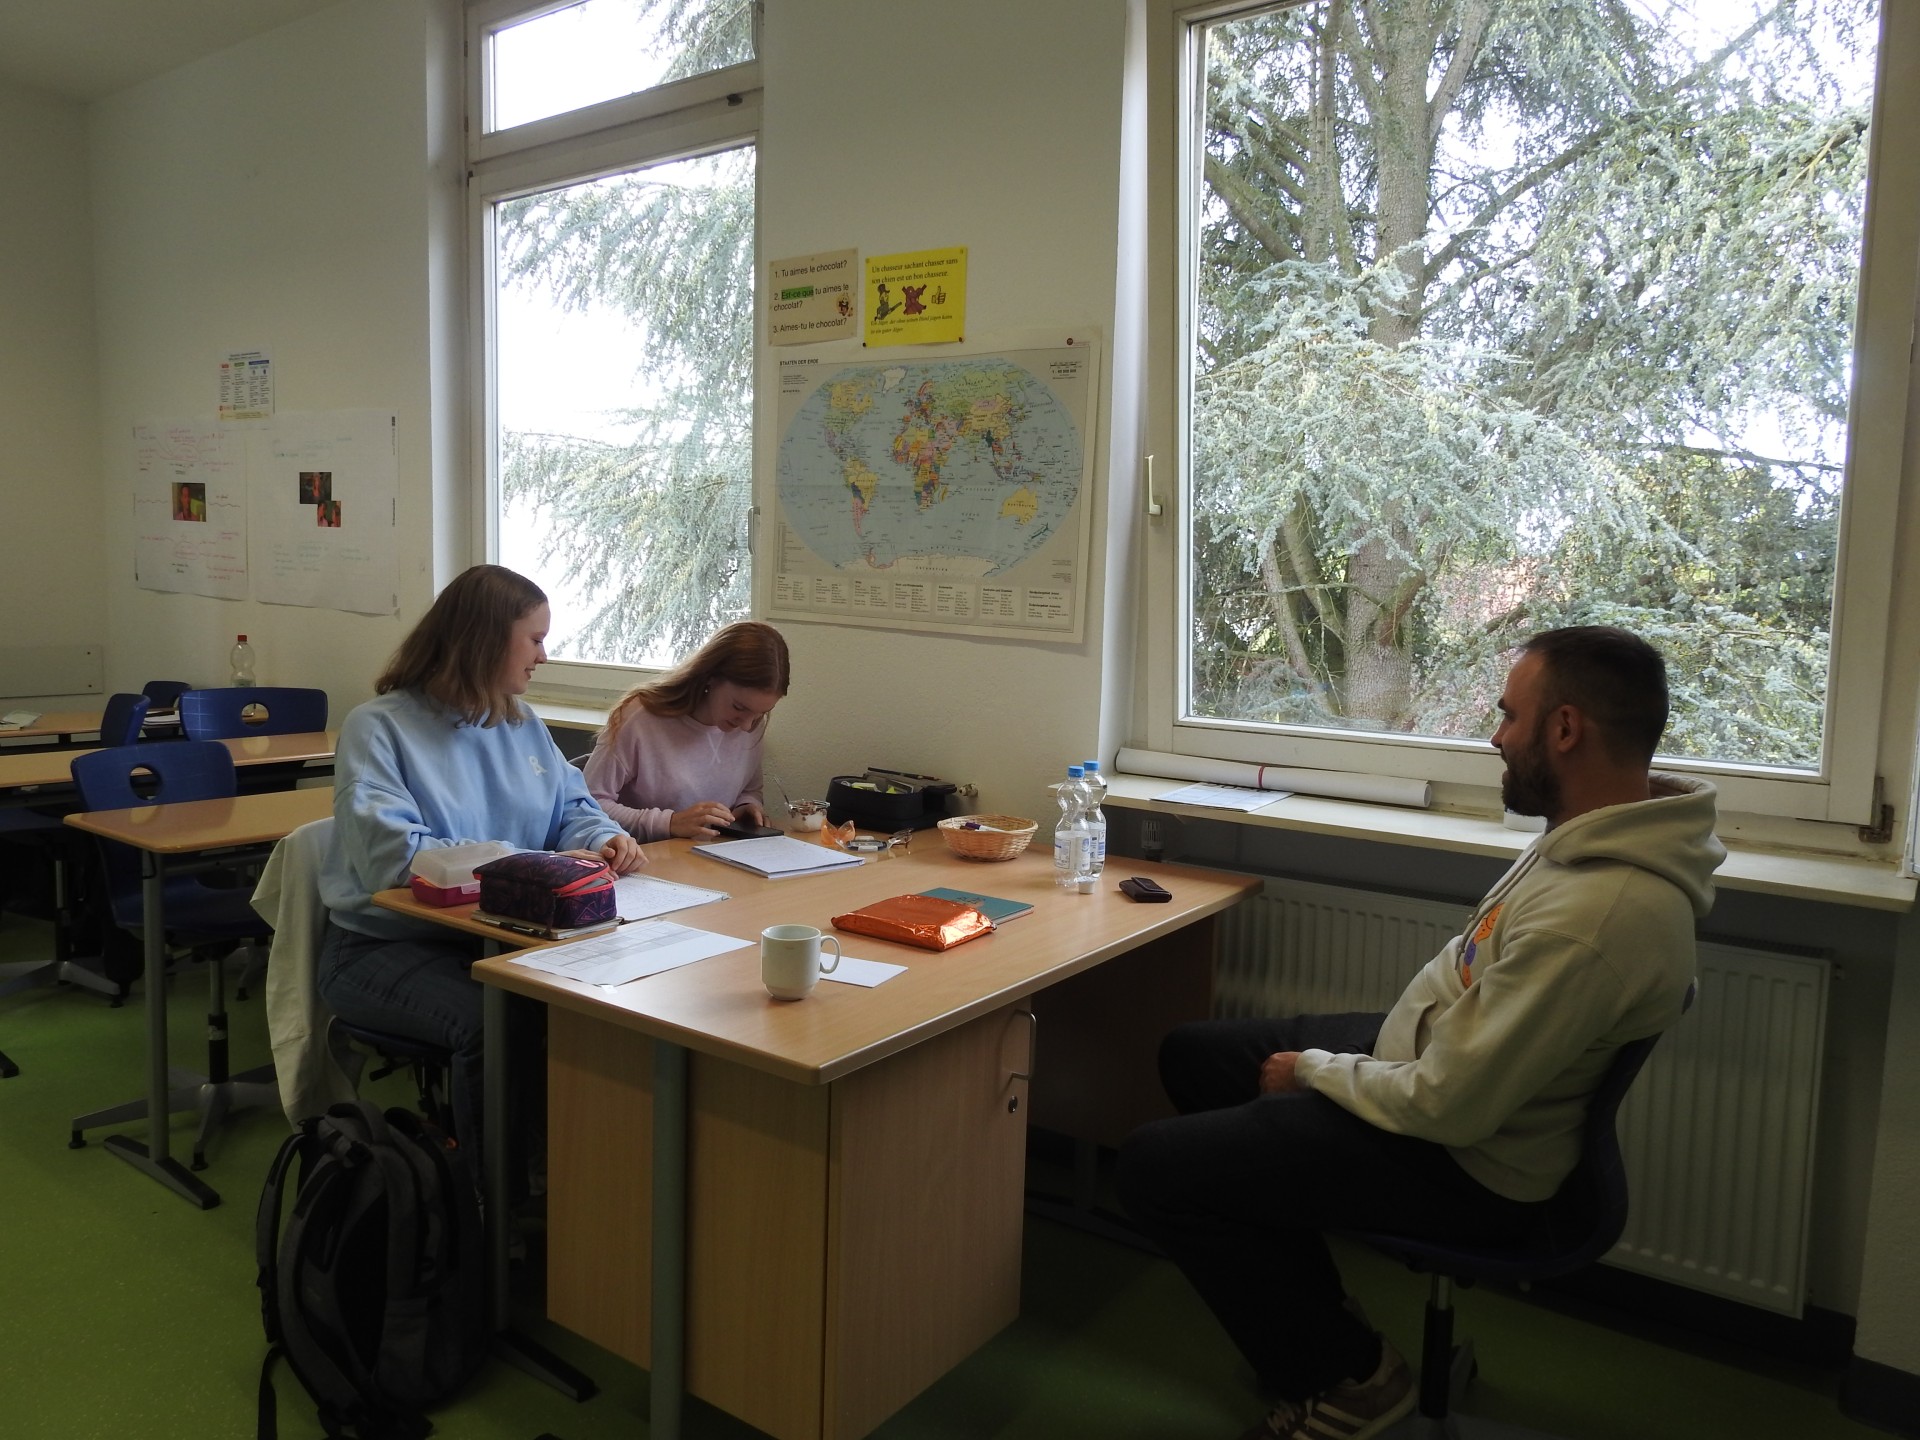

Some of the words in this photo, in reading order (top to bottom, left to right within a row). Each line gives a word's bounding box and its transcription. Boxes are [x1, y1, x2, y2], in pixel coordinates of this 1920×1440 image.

[781, 269, 789, 277] Tu
[789, 267, 808, 276] aimes
[809, 265, 815, 273] le
[816, 260, 847, 272] chocolat?
[881, 264, 903, 272] chasseur
[904, 261, 924, 270] sachant
[924, 259, 945, 267] chasser
[913, 272, 923, 280] bon
[802, 288, 814, 298] que
[815, 287, 822, 295] tu
[822, 285, 842, 294] aimes
[773, 300, 803, 311] chocolat?
[779, 322, 807, 333] Aimes-tu
[808, 321, 815, 329] le
[816, 318, 847, 328] chocolat?
